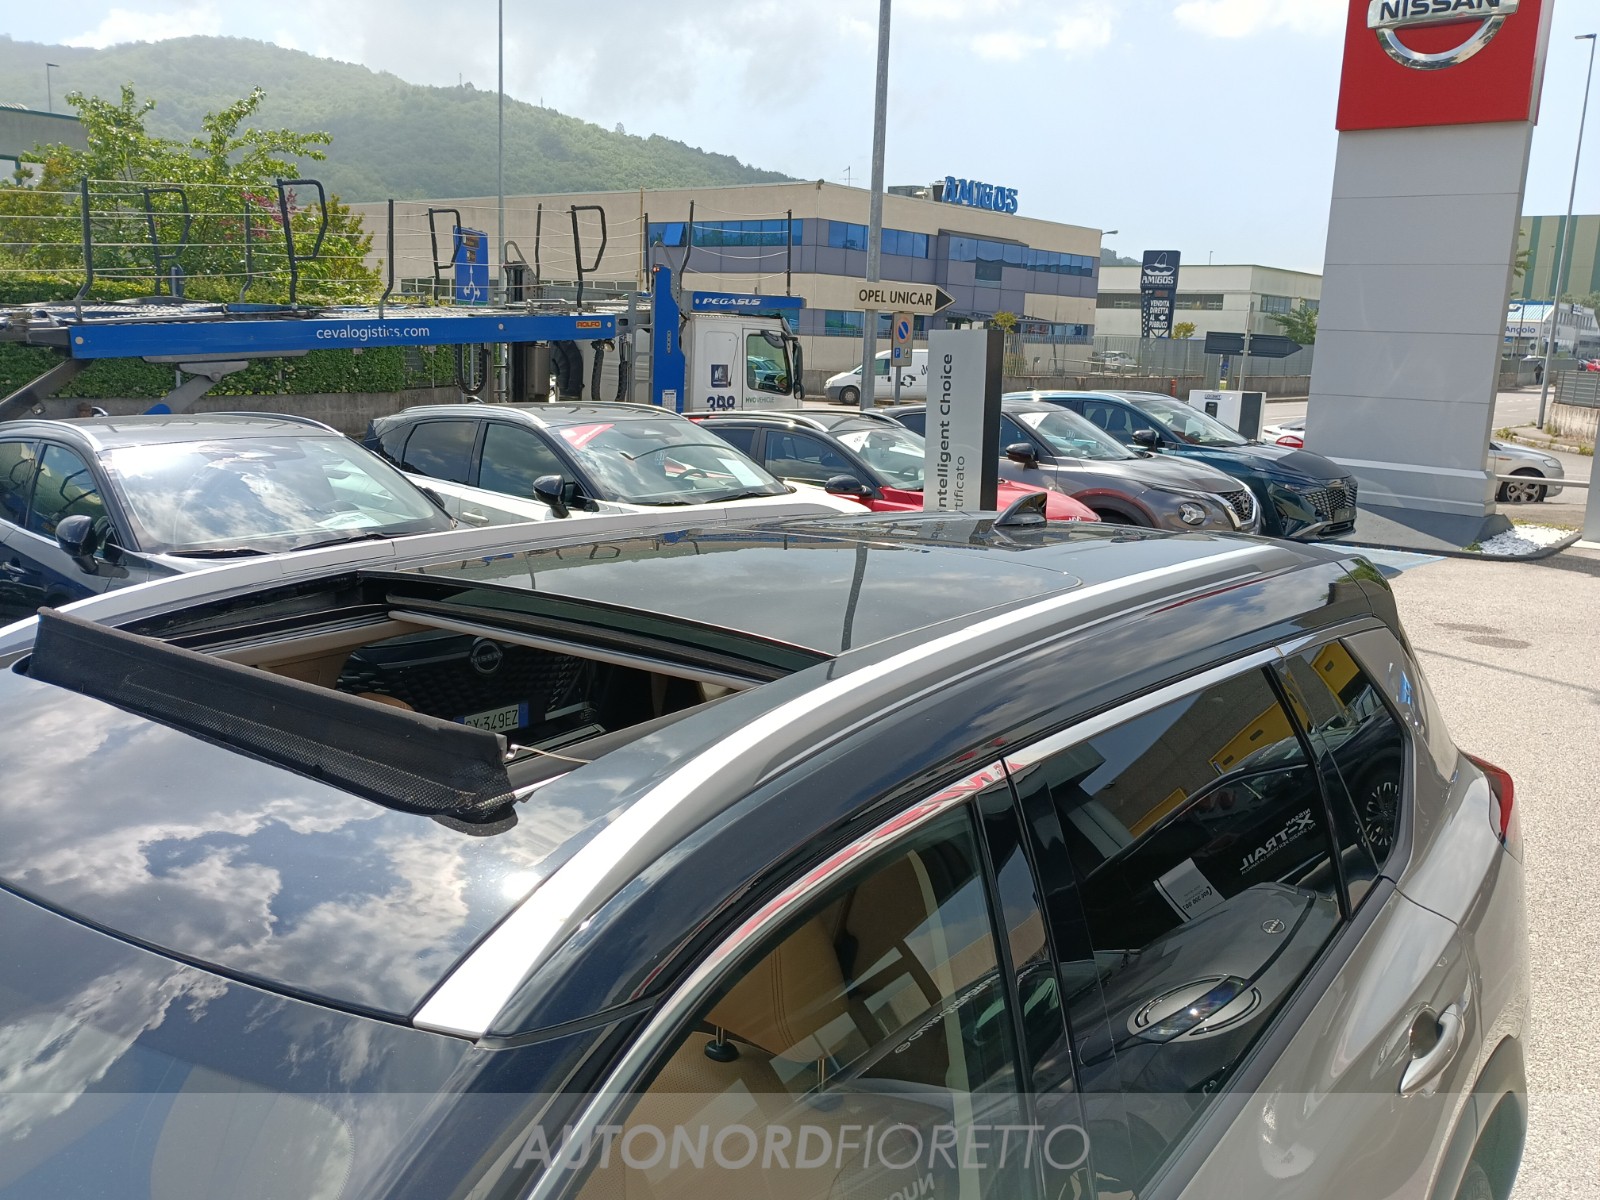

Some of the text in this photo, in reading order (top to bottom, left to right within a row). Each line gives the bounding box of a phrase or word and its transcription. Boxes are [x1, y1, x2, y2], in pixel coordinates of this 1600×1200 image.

[942, 176, 1018, 214] AMIGOS
[1142, 276, 1174, 284] AMIGOS
[702, 297, 761, 305] PEGASUS
[859, 289, 933, 306] OPEL UNICAR
[316, 325, 430, 341] cevalogistics.com
[936, 354, 952, 512] ntelligent Choice
